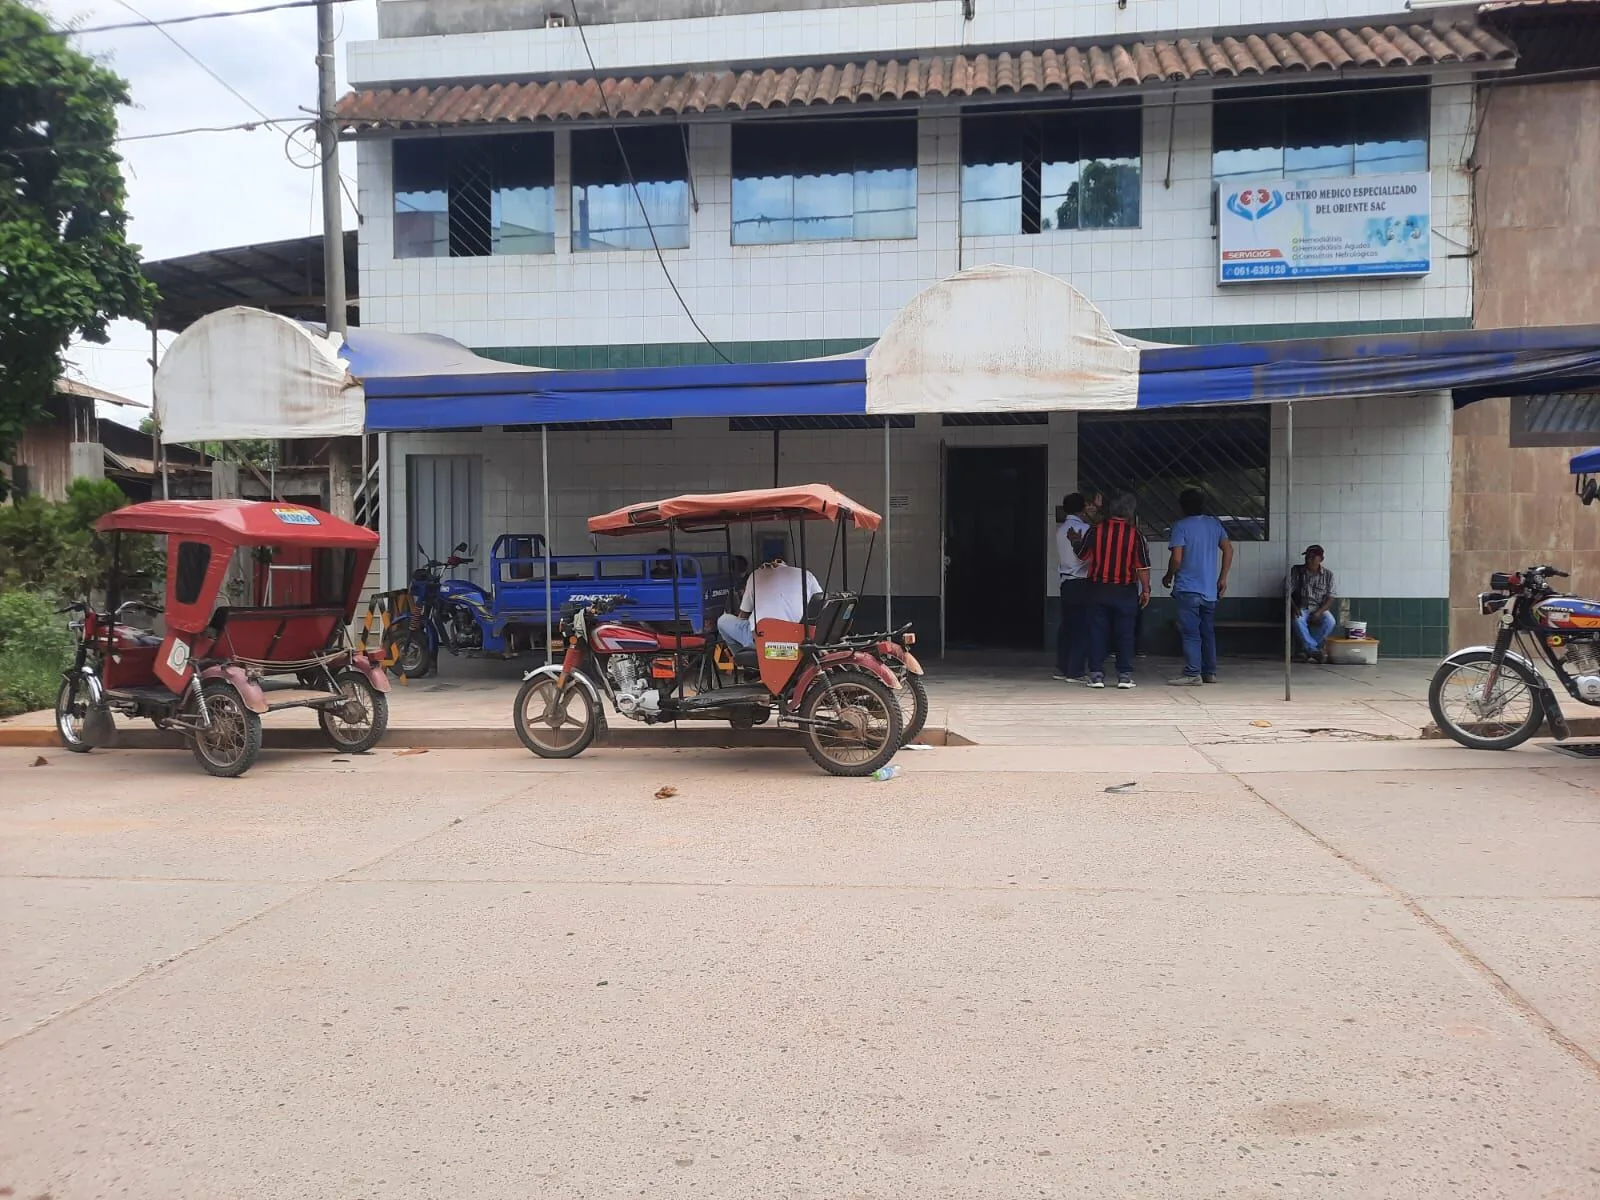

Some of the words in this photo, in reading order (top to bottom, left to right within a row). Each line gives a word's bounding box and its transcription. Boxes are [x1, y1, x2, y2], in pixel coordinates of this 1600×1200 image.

[1285, 190, 1318, 201] CENTRO
[1320, 188, 1352, 199] MEDICO
[1353, 184, 1417, 197] ESPECIALIZADO
[1315, 203, 1332, 214] DEL
[1333, 202, 1369, 213] ORIENTE
[1370, 201, 1387, 211] SAC
[1228, 250, 1271, 259] SERVICIOS
[1233, 265, 1286, 276] 061-638128
